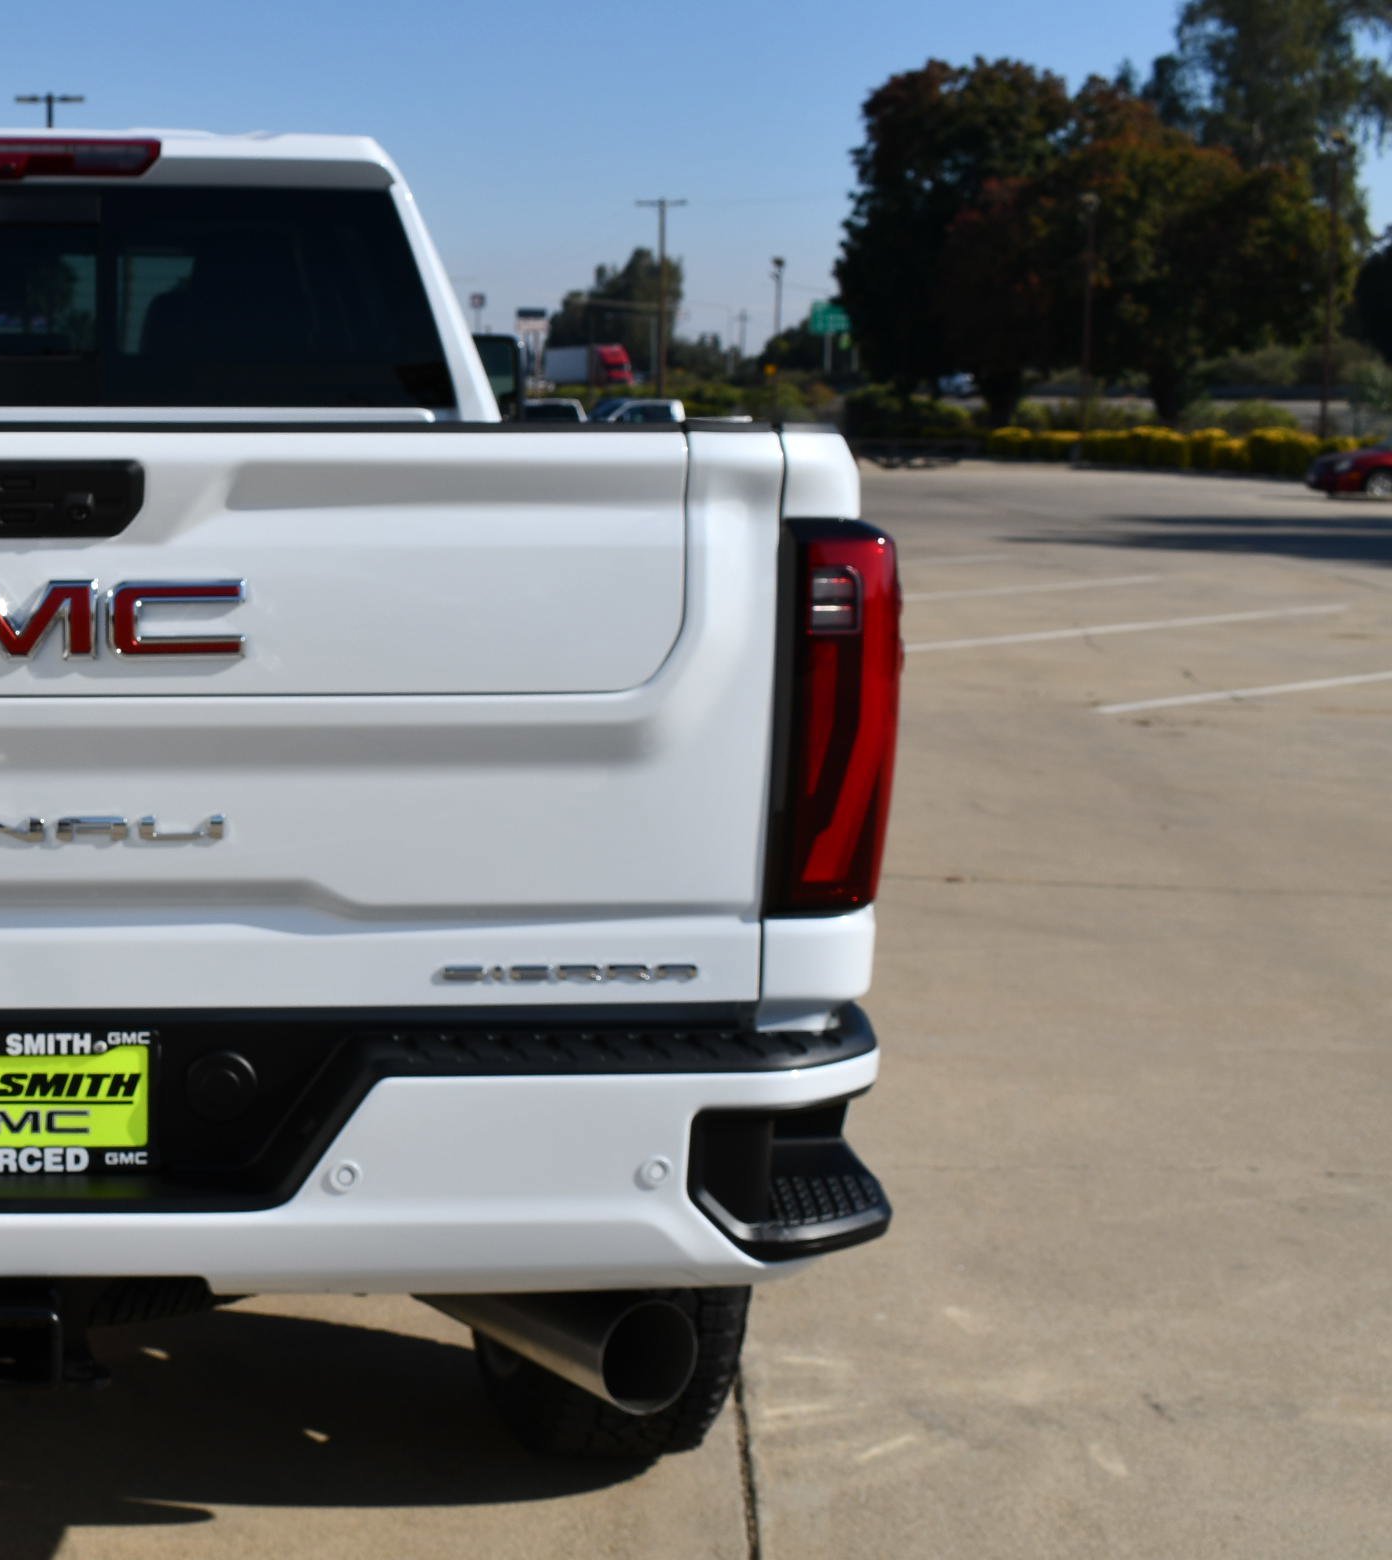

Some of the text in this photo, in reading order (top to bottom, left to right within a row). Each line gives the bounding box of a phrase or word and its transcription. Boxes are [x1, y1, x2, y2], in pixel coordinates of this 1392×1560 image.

[442, 964, 697, 983] SIERRA
[6, 1033, 92, 1055] SMITH
[107, 1032, 150, 1045] GMC
[105, 1152, 148, 1165] GMC
